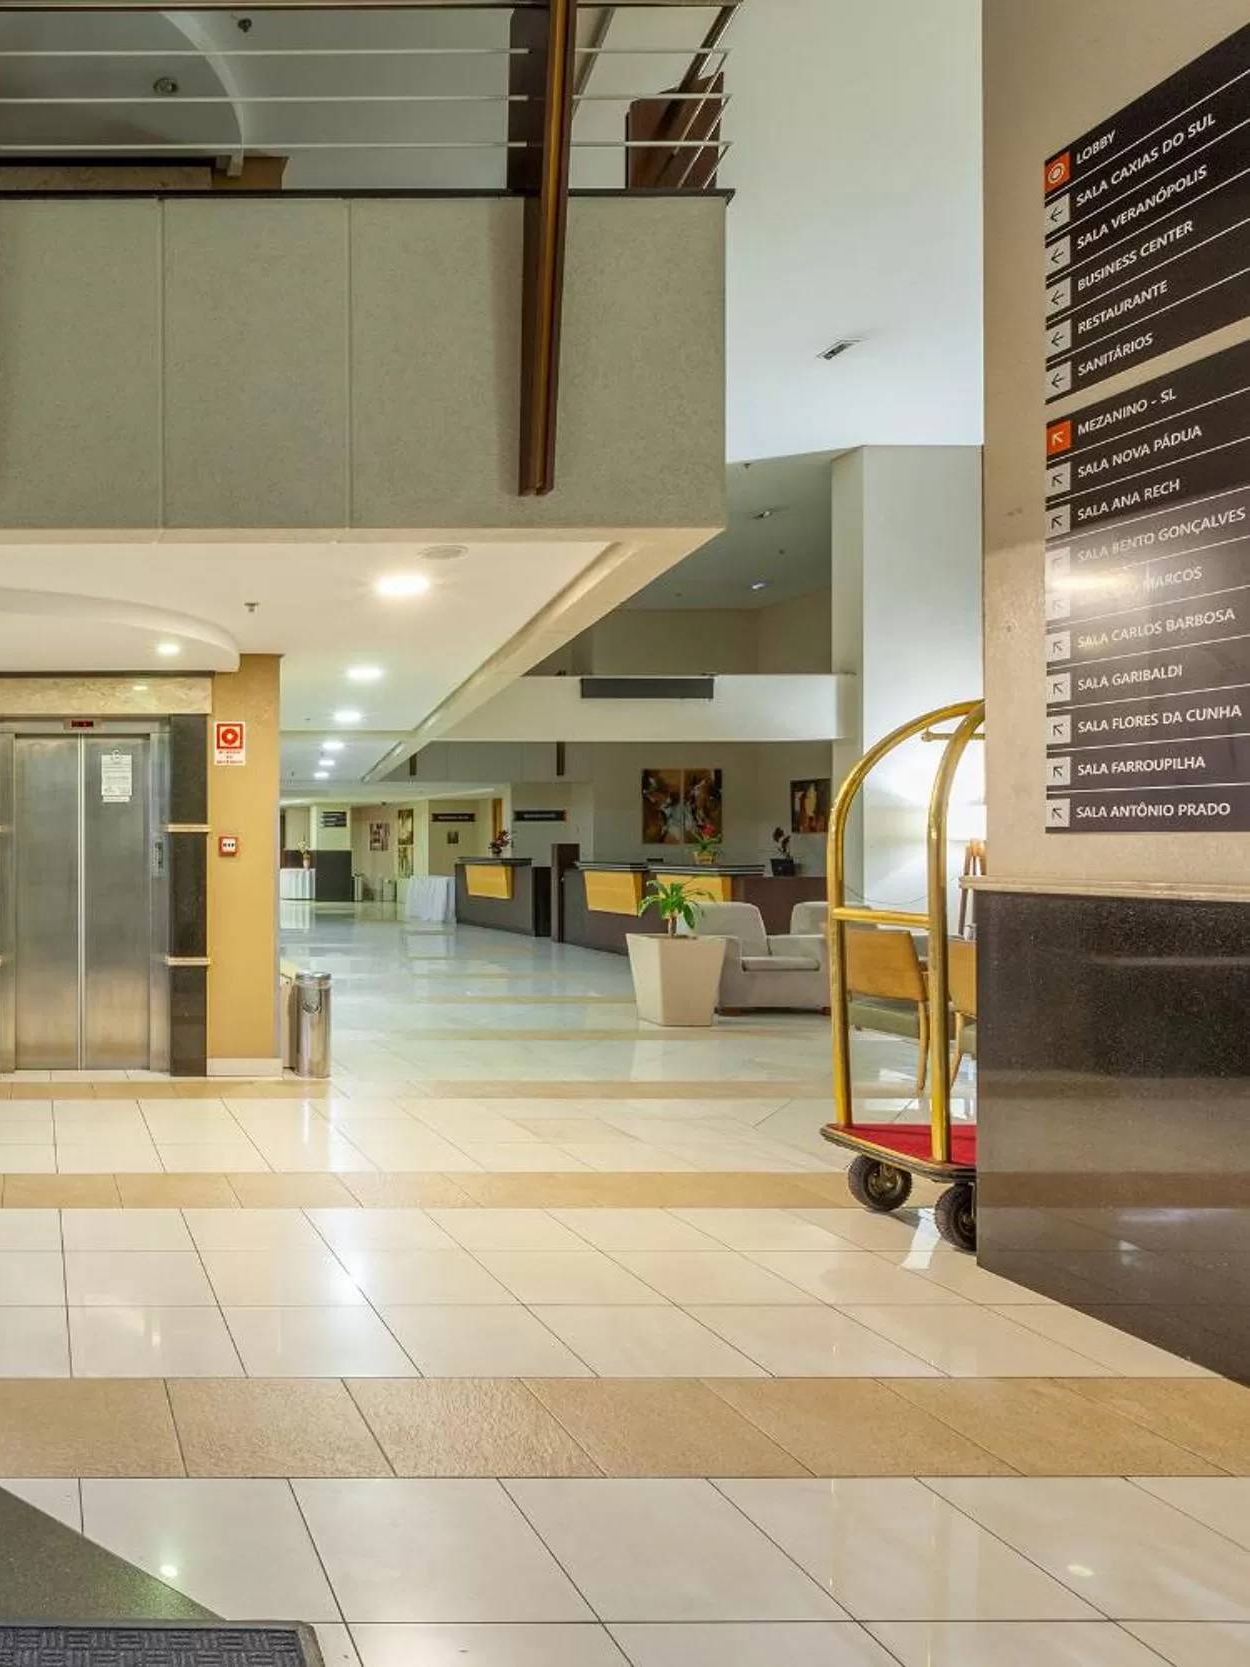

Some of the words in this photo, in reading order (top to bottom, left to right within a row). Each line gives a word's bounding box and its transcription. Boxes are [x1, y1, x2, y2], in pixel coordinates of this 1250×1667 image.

[1076, 130, 1116, 165] LOBBY
[1076, 180, 1109, 206] SALA
[1110, 148, 1158, 186] CAXIAS
[1162, 132, 1185, 154] DO
[1188, 113, 1216, 140] SUL
[1077, 224, 1109, 250] SALA
[1110, 164, 1208, 230] VERANÓPOLIS
[1078, 250, 1136, 291] BUSINESS
[1140, 220, 1193, 258] CENTER
[1078, 280, 1168, 334] RESTAURANTE
[1078, 332, 1153, 376] SANITÁRIOS
[1078, 400, 1148, 436] MEZANINO
[1160, 388, 1176, 403] SL
[1078, 458, 1109, 478] SALA
[1112, 443, 1150, 466] NOVA
[1153, 426, 1202, 452] PÁDUA
[1078, 501, 1108, 521] SALA
[1111, 492, 1140, 512] ANA
[1144, 478, 1180, 501] RECH
[1077, 546, 1109, 562] SALA
[1158, 506, 1246, 541] GONÇALVES
[1077, 634, 1109, 648] SALA
[1112, 620, 1162, 642] CARLOS
[1166, 608, 1236, 631] BARBOSA
[1078, 675, 1108, 692] SALA
[1112, 664, 1182, 688] GARIBALDI
[1078, 718, 1109, 733] SALA
[1112, 712, 1158, 730] FLORES
[1162, 711, 1182, 724] DA
[1186, 704, 1242, 722] CUNHA
[1077, 762, 1108, 776] SALA
[1111, 755, 1205, 774] FARROUPILHA
[1076, 804, 1108, 818] SALA
[1110, 800, 1174, 818] ANTÔNIO
[1178, 802, 1230, 816] PRADO
